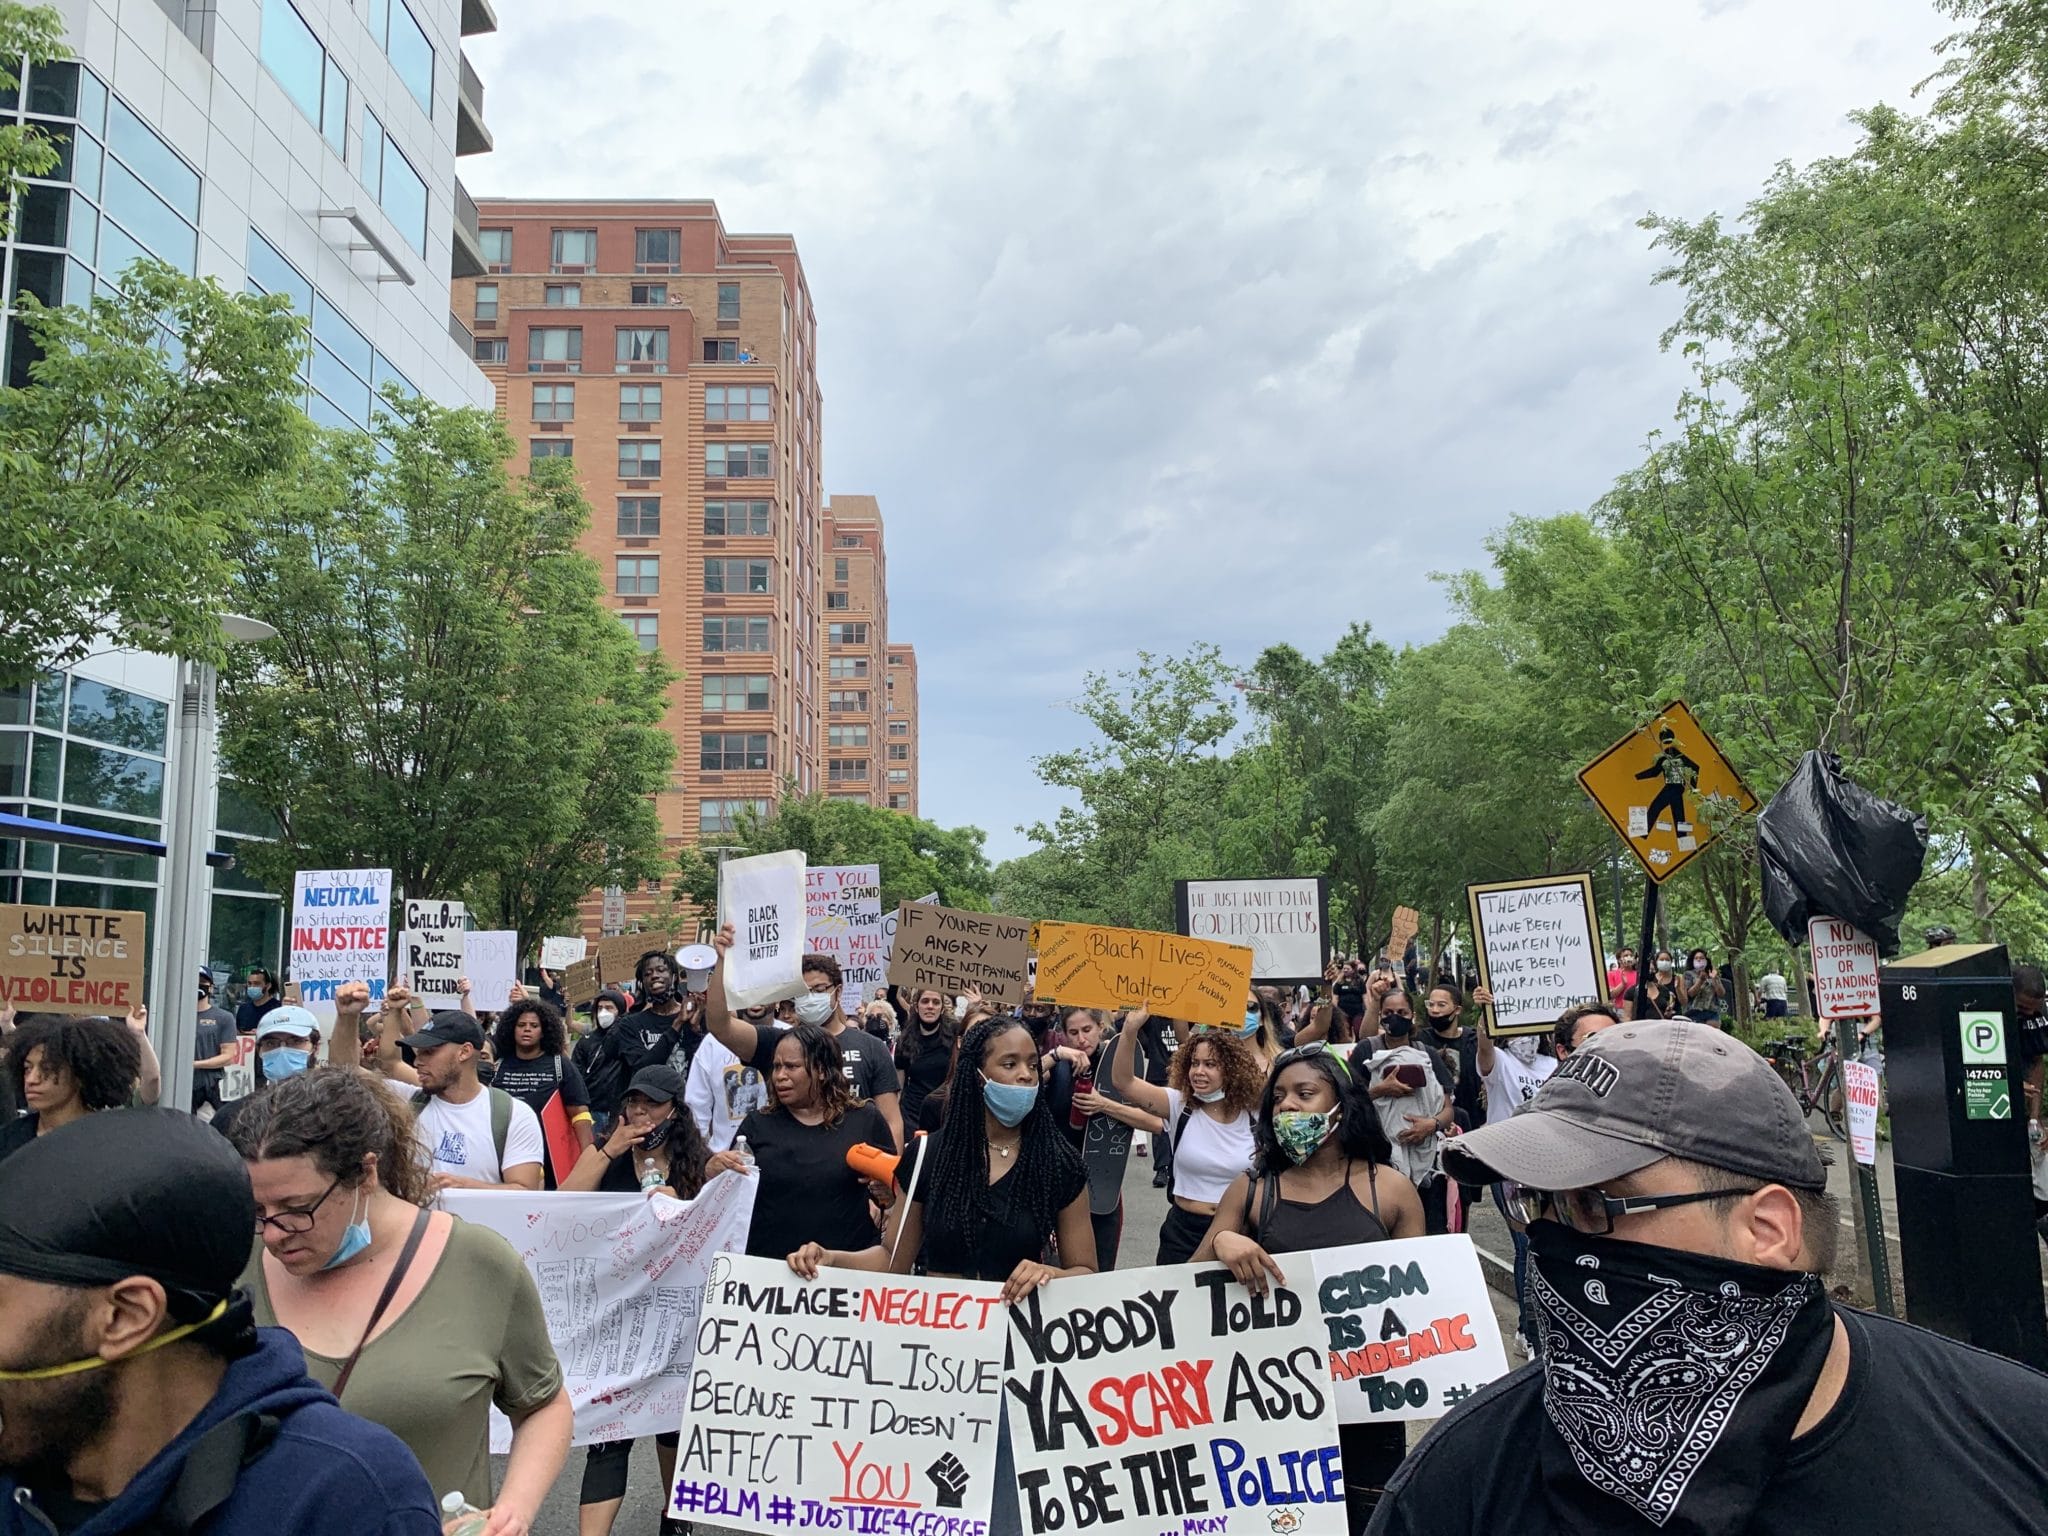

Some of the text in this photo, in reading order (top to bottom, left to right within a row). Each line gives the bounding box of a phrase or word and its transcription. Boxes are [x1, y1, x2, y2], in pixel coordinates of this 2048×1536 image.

[301, 871, 388, 888] IF YOU ARE
[806, 872, 867, 886] IF YOU
[304, 887, 379, 906] NEUTRAL
[841, 886, 879, 900] STAND
[1213, 891, 1239, 907] JUST
[1481, 890, 1584, 913] THE ANCESTORS
[294, 911, 387, 926] in situations of
[749, 904, 778, 923] BLACK
[828, 903, 859, 917] SOME
[847, 913, 880, 926] THING
[24, 912, 121, 939] WHITE
[750, 923, 779, 945] LIVES
[904, 908, 923, 927] IF
[996, 925, 1028, 941] NOT
[1192, 911, 1317, 935] GOD PROTECT US
[1489, 918, 1561, 937] HAVE BEEN
[1830, 923, 1854, 942] NO
[8, 935, 128, 958] SILENCE
[293, 928, 386, 951] INJUSTICE
[423, 932, 445, 943] YOUR
[809, 934, 882, 951] YOU WILL
[925, 935, 988, 958] ANGRY
[1040, 935, 1069, 959] Targeted
[1489, 935, 1581, 955] AWAKEN YOU
[292, 952, 385, 968] you have chosen
[410, 945, 462, 969] RACIST
[750, 945, 778, 961] MATTER
[850, 953, 877, 966] FOR
[1089, 934, 1206, 967] Black Lives
[1816, 942, 1872, 959] STOPPING
[50, 956, 86, 979] IS
[297, 964, 380, 979] the side of the
[960, 961, 982, 977] NOT
[983, 964, 1021, 981] PAYING
[1490, 956, 1566, 976] HAVE BEEN
[1838, 960, 1854, 973] OR
[0, 976, 129, 1006] VIOLENCE
[414, 970, 463, 994] FRIEND
[916, 968, 1005, 996] ATTENTION
[1117, 975, 1172, 999] Matter
[1207, 971, 1231, 991] racism
[1492, 974, 1565, 993] WARNED
[1819, 975, 1877, 990] STANDING
[1197, 981, 1227, 1008] brutality
[1824, 992, 1844, 1002] 9AM
[1857, 990, 1877, 1000] 9PM
[1902, 985, 1916, 1000] 86
[1975, 1026, 1992, 1047] P
[1318, 1260, 1429, 1314] CISM
[860, 1287, 1000, 1331] NEGLECT
[1004, 1285, 1179, 1371] NOBODY
[1324, 1308, 1407, 1351] IS A
[697, 1317, 738, 1356] OF
[736, 1323, 762, 1366] A
[772, 1327, 893, 1386] SOCIAL
[899, 1343, 1000, 1395] ISSUE
[1328, 1313, 1477, 1382] ANDEMIC
[1005, 1346, 1325, 1453] YA SCARY ASS
[1359, 1375, 1429, 1414] TOO
[690, 1370, 795, 1419] BECAUSE
[810, 1396, 859, 1429] IT
[870, 1399, 992, 1443] DOESN'T
[680, 1423, 910, 1501] AFFECT YOU
[1063, 1461, 1124, 1529] BE
[1120, 1443, 1209, 1518] THE
[673, 1479, 761, 1522] #BLM
